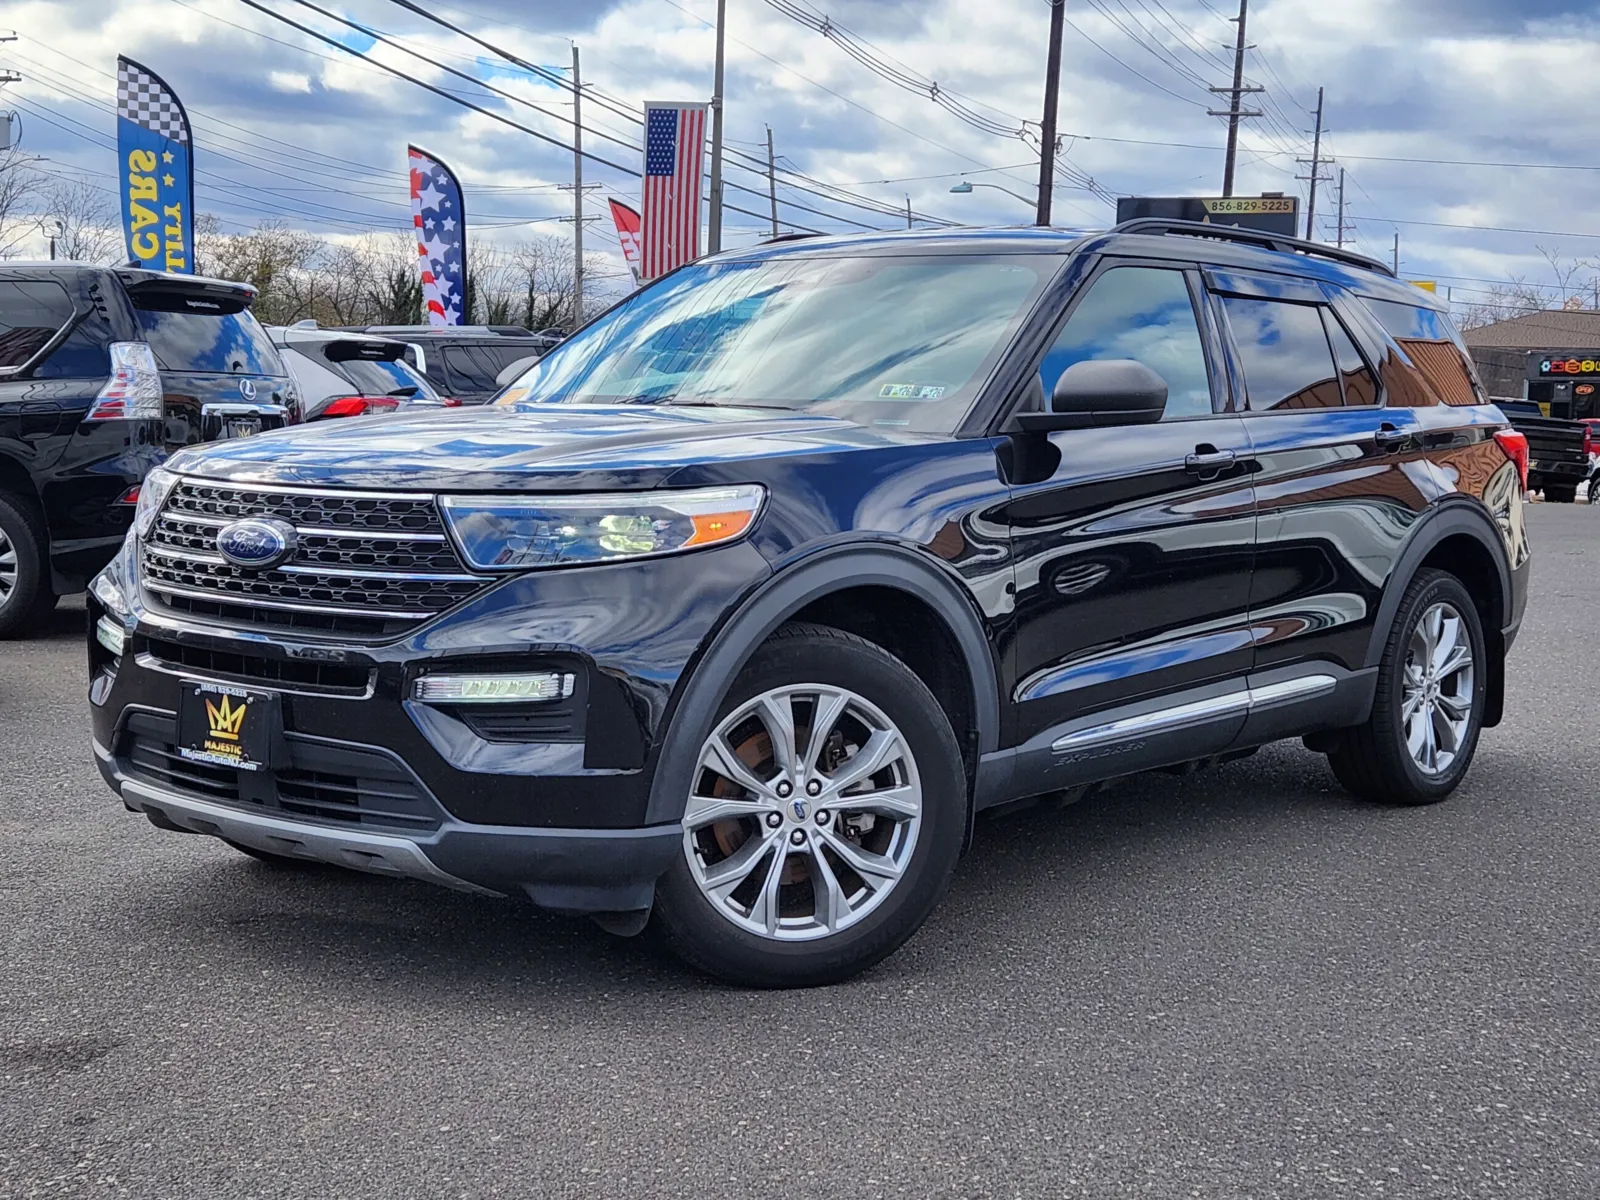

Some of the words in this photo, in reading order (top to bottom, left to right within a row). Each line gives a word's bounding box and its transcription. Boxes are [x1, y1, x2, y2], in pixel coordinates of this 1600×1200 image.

[1212, 200, 1290, 211] 856-829-5225
[229, 529, 266, 555] Ford
[204, 740, 243, 755] MAJESTIC
[181, 748, 257, 771] MajesticAutoNJ.com
